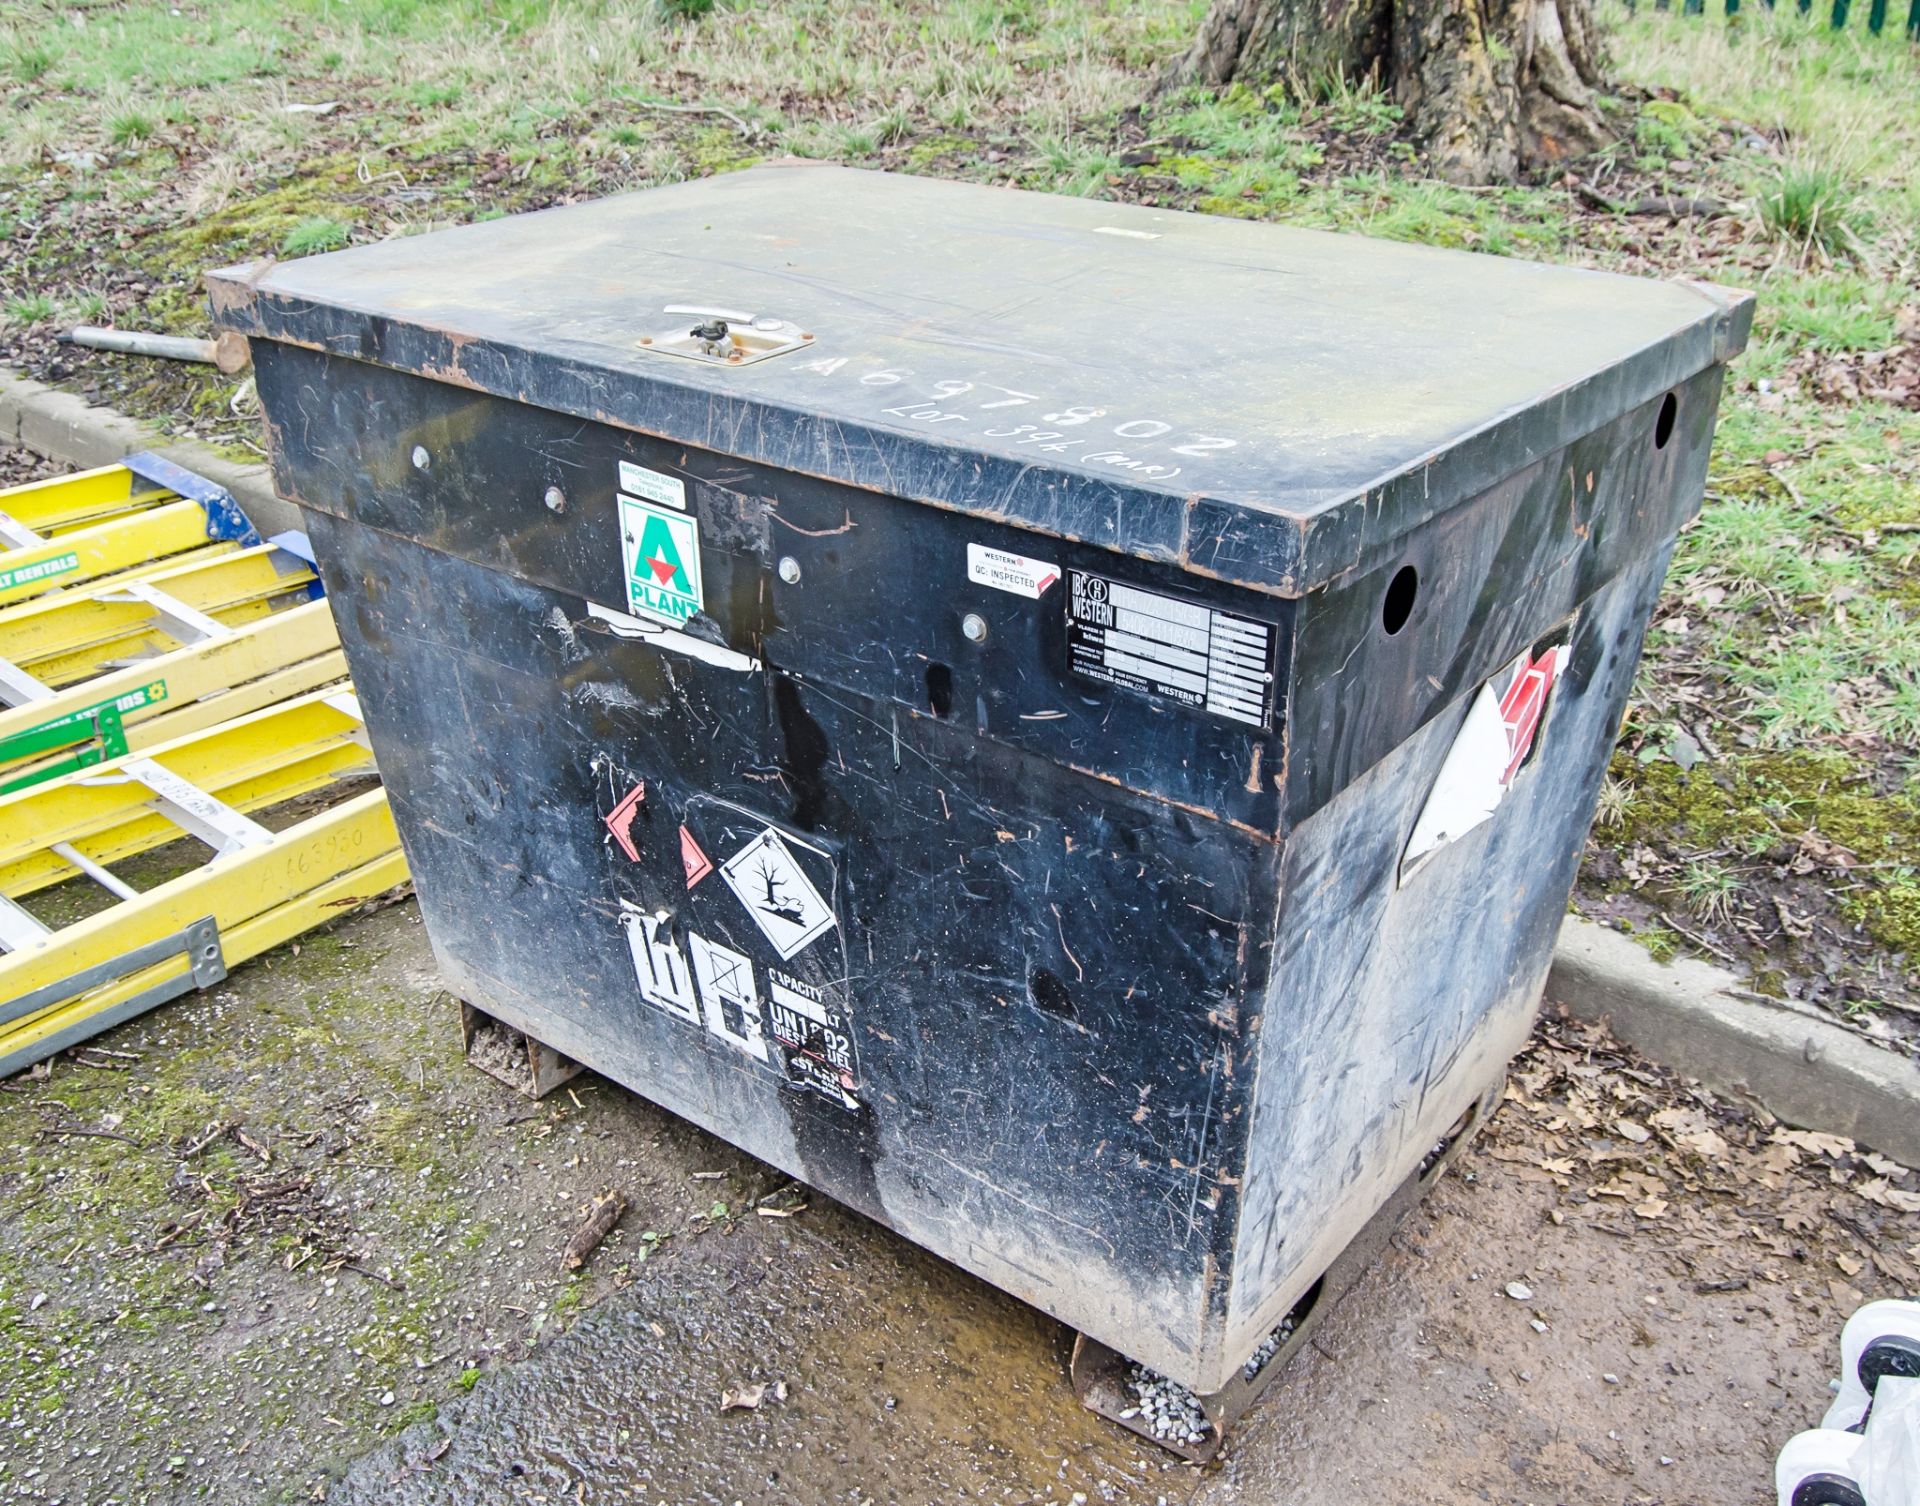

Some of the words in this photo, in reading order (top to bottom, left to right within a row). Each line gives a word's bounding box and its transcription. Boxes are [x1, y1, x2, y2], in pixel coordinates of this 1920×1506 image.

[634, 515, 694, 595] A
[984, 552, 1016, 565] WESTERN
[14, 554, 78, 584] RENTALS
[991, 569, 1035, 588] INSPECTED
[1072, 573, 1087, 597] IBC
[630, 581, 699, 619] PLANT
[1072, 595, 1113, 627] WESTERN
[1157, 684, 1194, 702] WESTERN
[768, 967, 823, 1002] CAPACITY
[827, 1014, 841, 1029] LT
